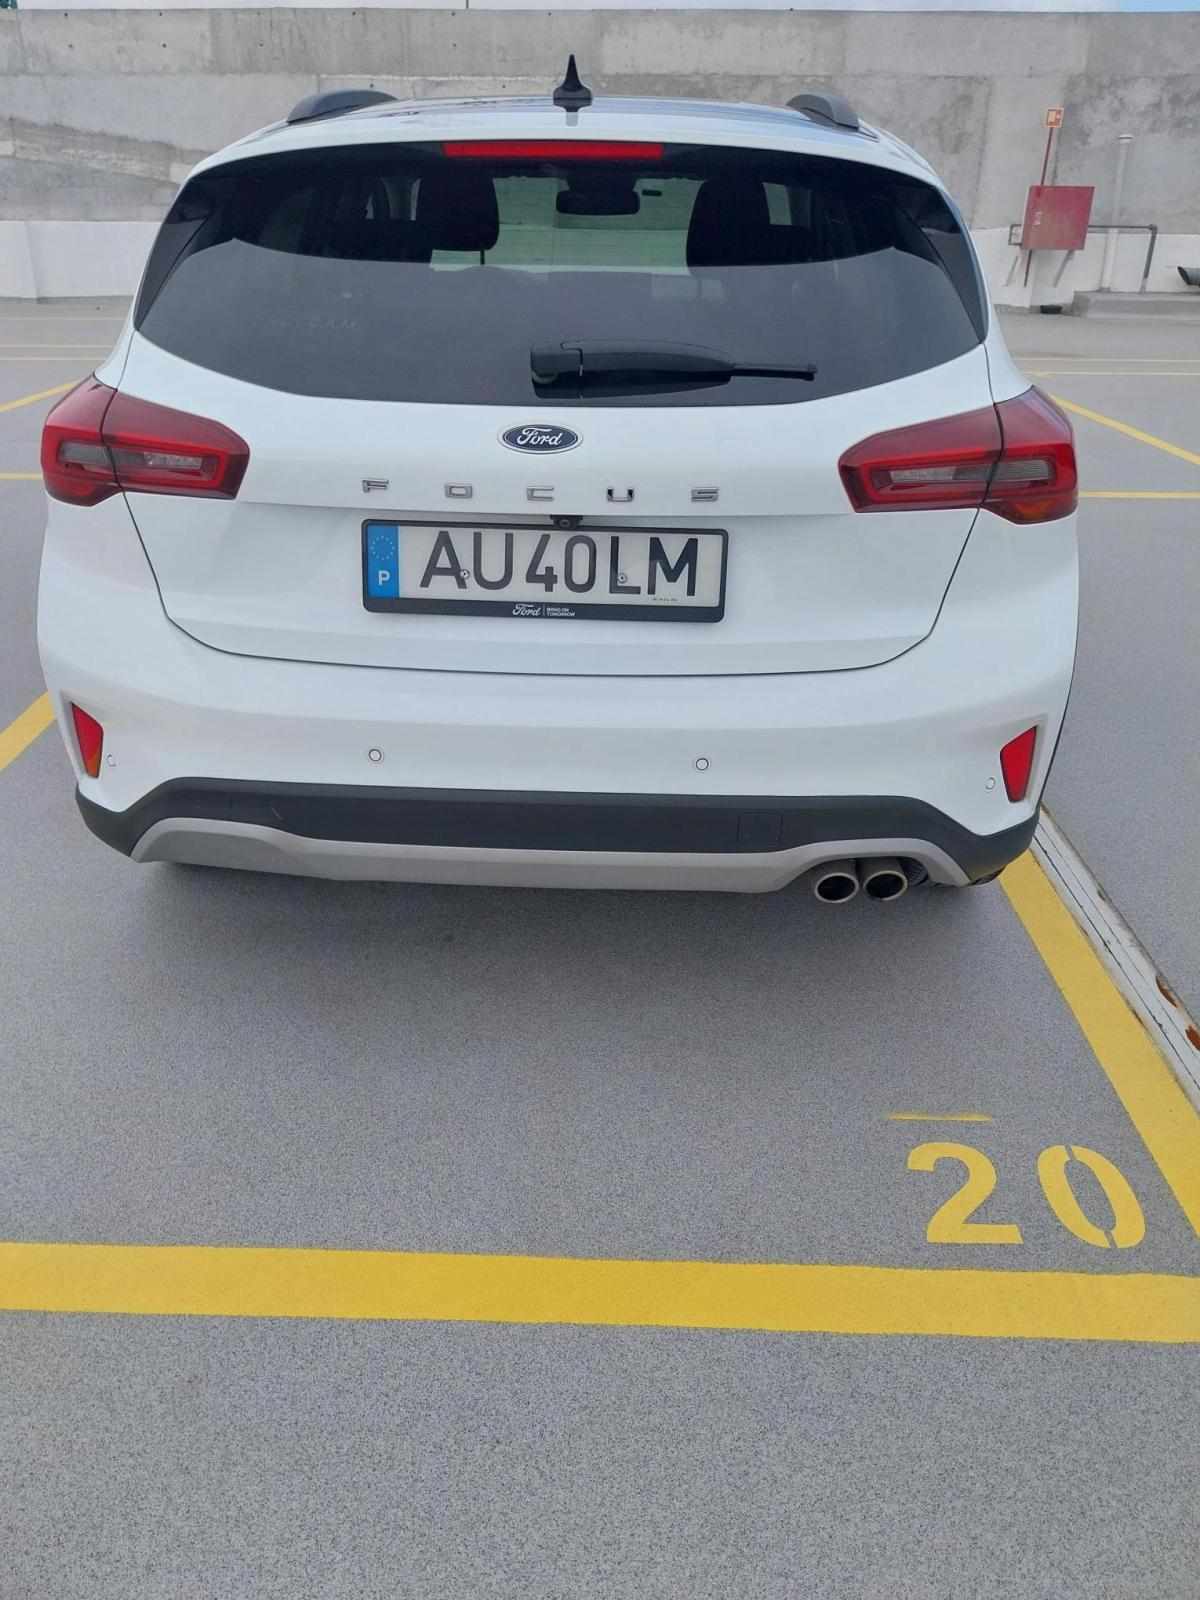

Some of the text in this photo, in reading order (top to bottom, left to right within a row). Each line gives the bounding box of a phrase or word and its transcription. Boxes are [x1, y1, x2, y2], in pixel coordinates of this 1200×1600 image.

[516, 426, 564, 446] Ford
[361, 479, 720, 503] FOCUS
[378, 570, 390, 586] P
[512, 603, 542, 616] Ford
[907, 1141, 1146, 1249] 20
